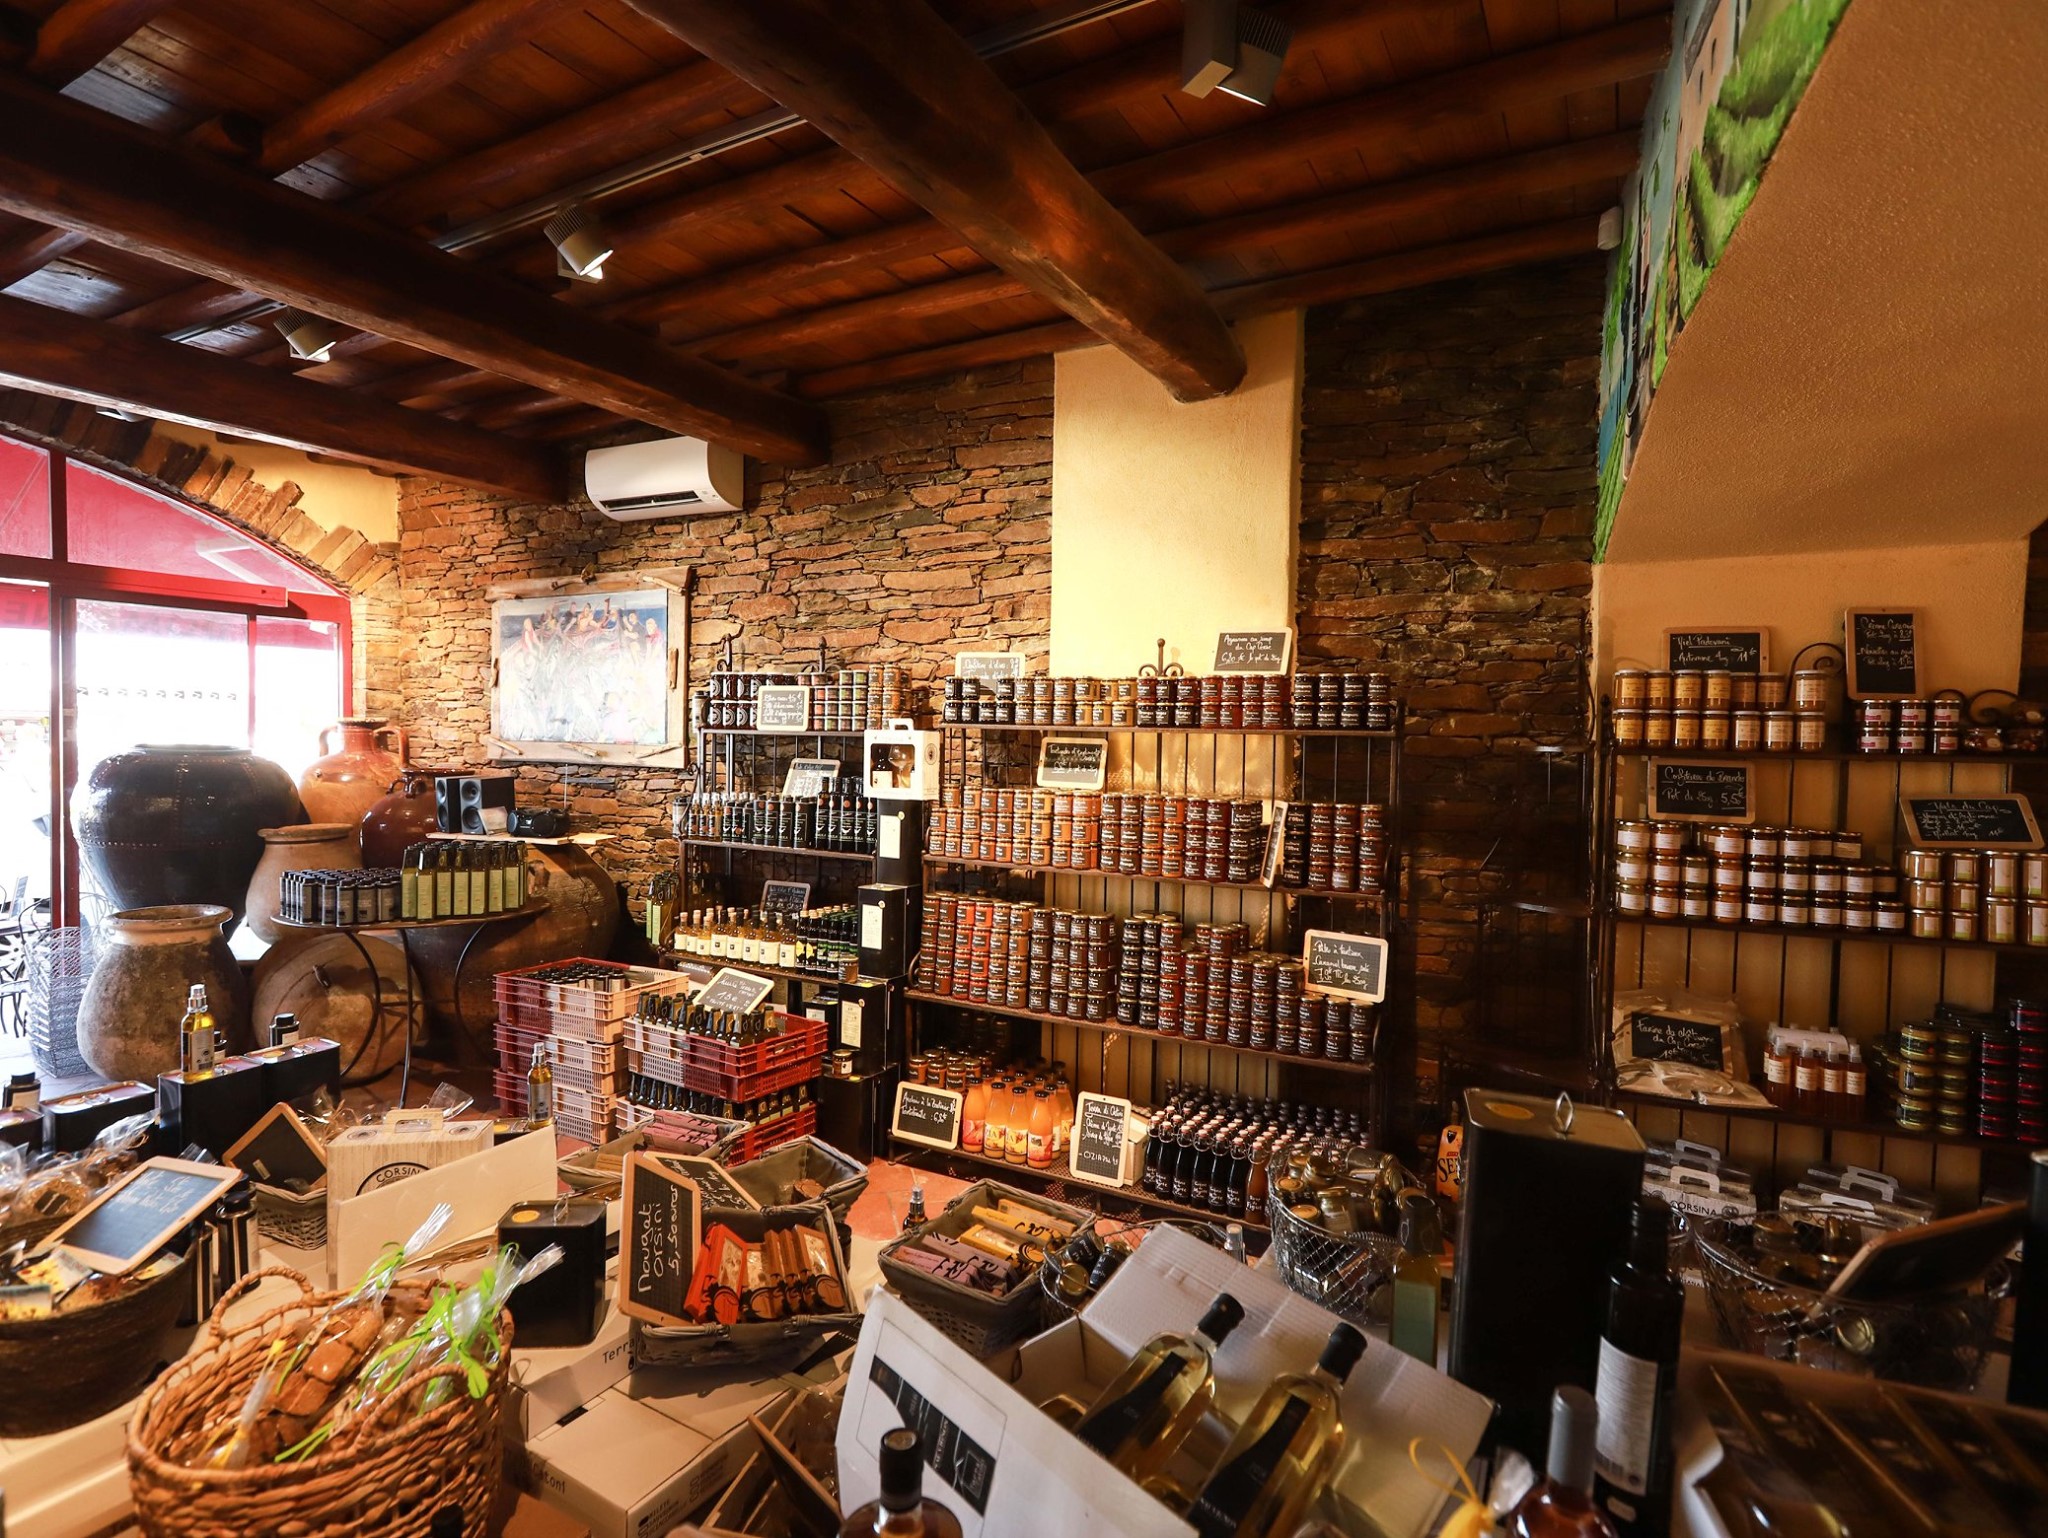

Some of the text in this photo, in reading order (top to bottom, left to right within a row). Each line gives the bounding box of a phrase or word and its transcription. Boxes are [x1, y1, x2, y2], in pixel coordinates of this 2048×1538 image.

[637, 1203, 654, 1293] Nougat
[653, 1203, 664, 1278] Orsini
[602, 1337, 635, 1363] Terra
